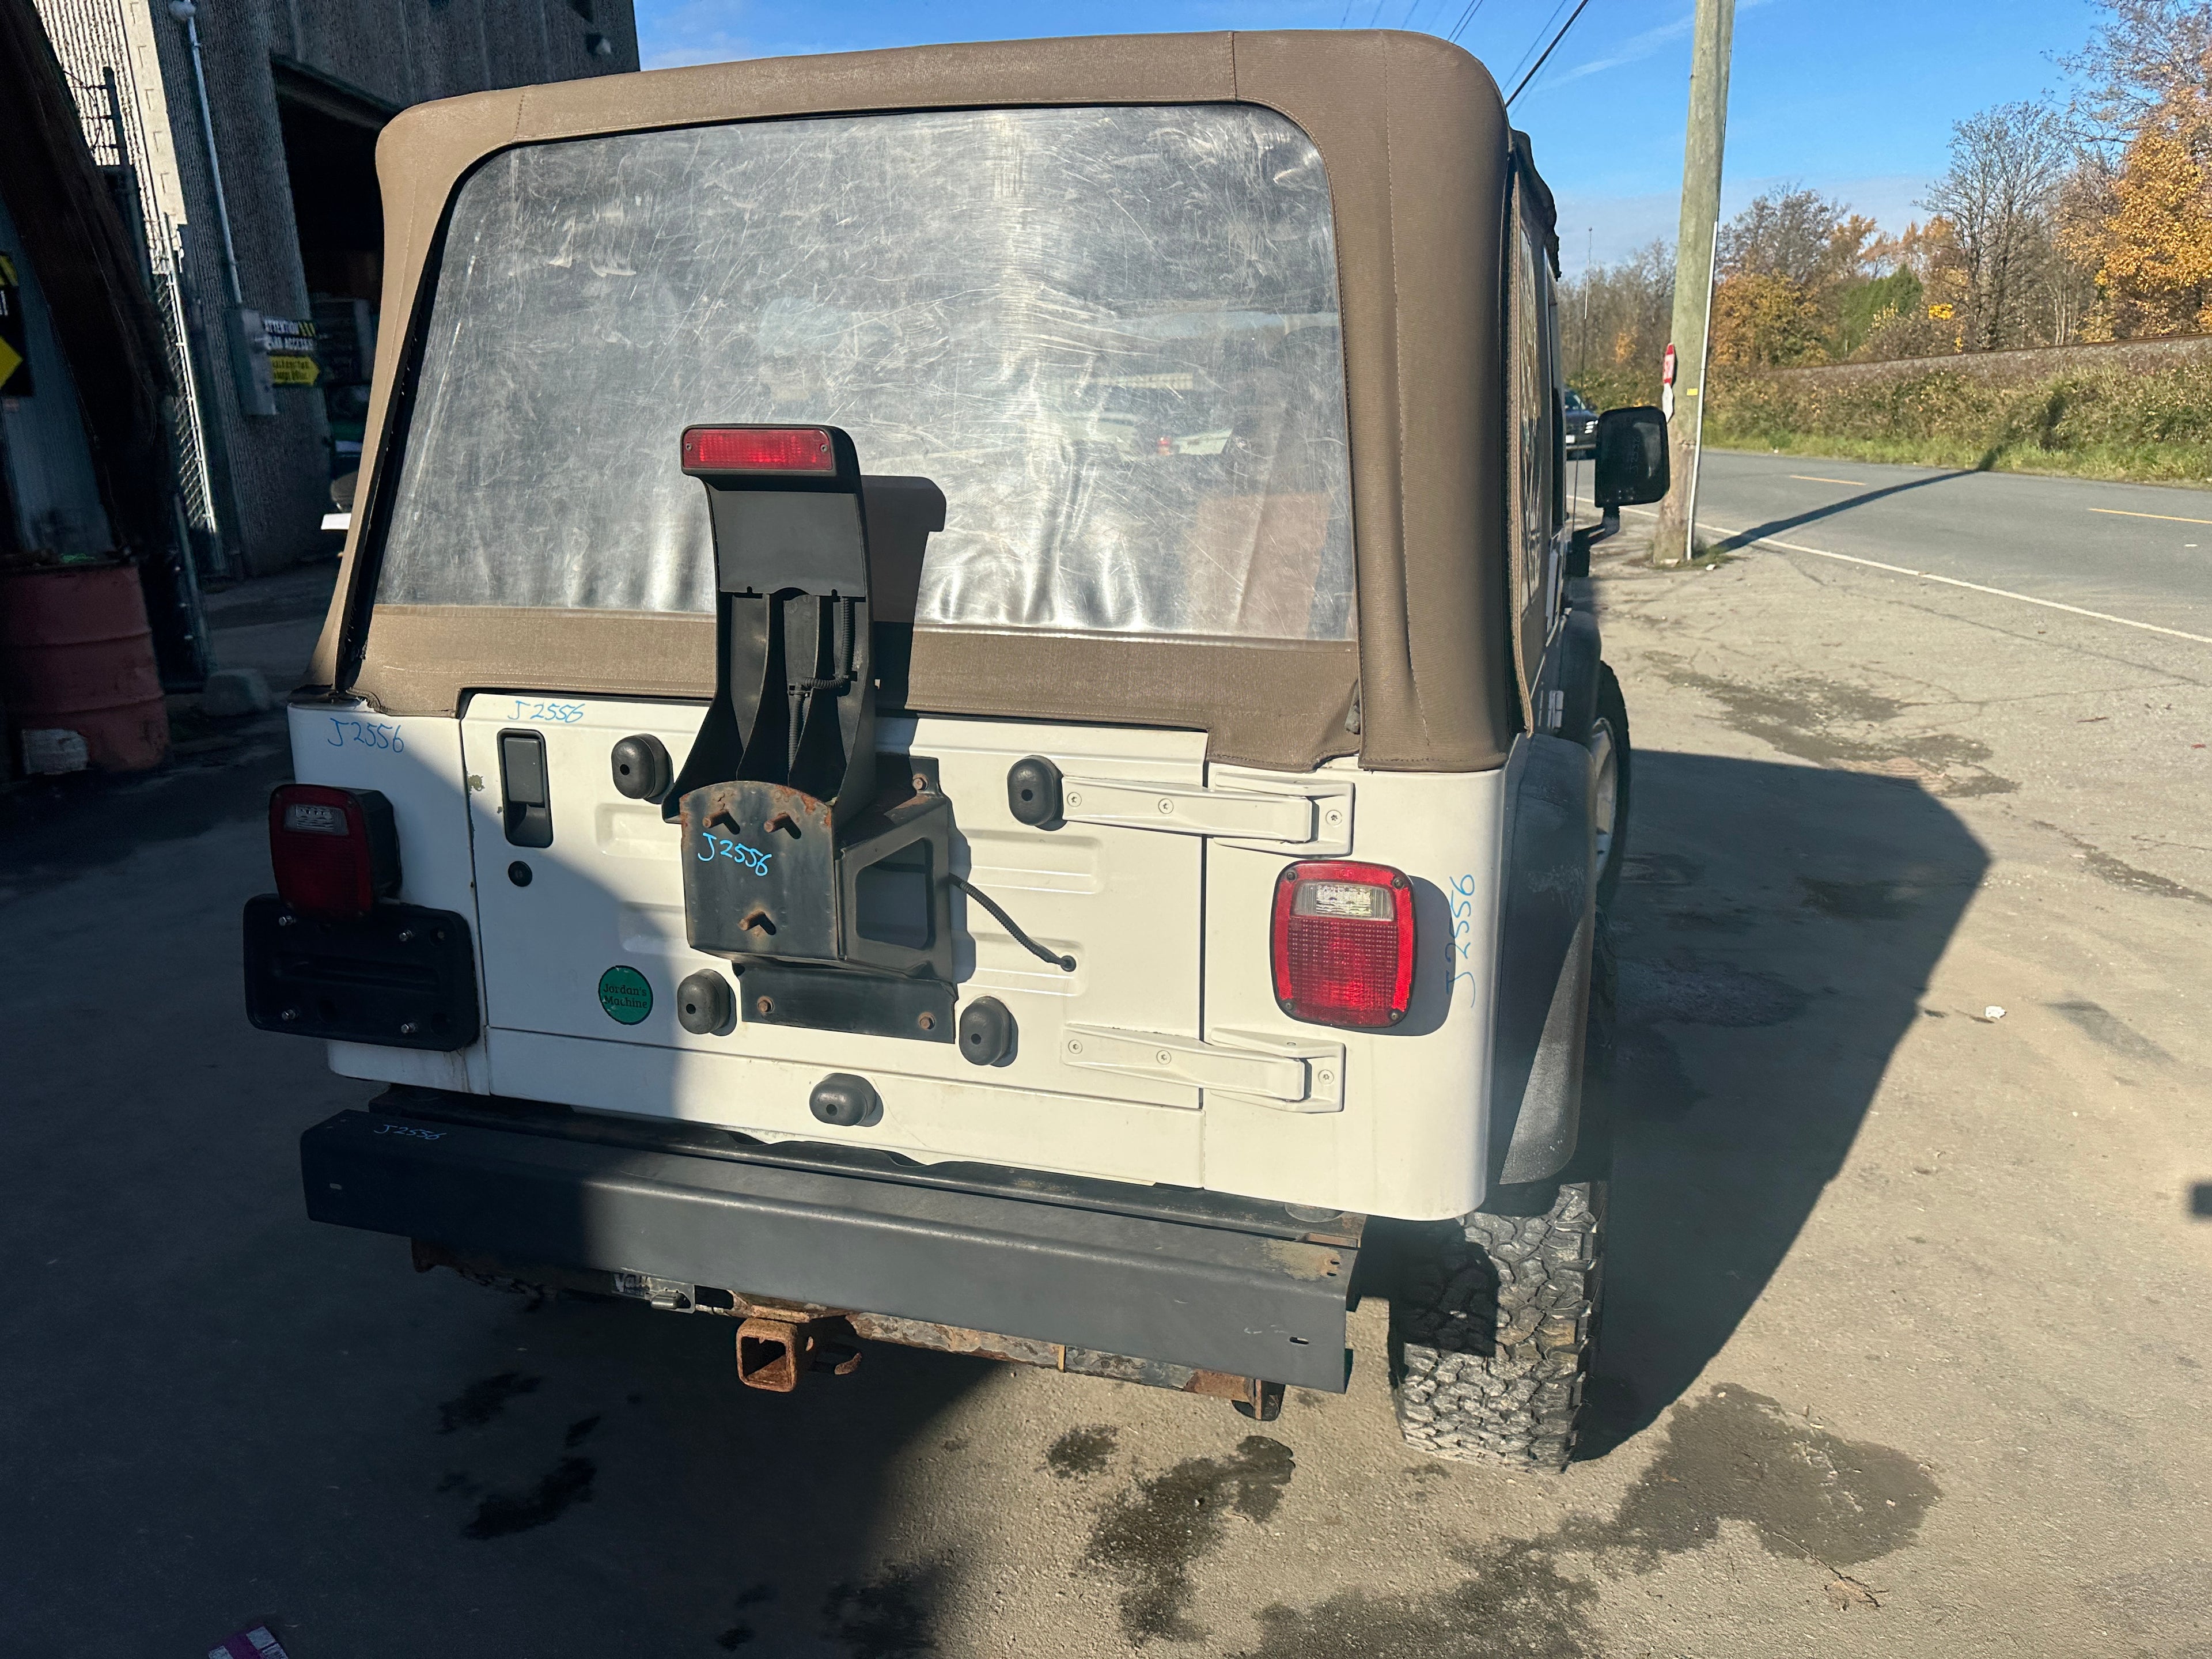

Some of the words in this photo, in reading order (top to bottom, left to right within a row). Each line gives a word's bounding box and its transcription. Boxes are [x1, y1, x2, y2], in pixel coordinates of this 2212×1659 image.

[507, 700, 586, 723] J2556
[327, 718, 404, 753] J2556
[697, 832, 772, 876] J2556
[1445, 874, 1475, 1008] J2556
[603, 983, 647, 997] Jordan's
[604, 995, 647, 1009] Machine
[373, 1124, 447, 1140] J2556
